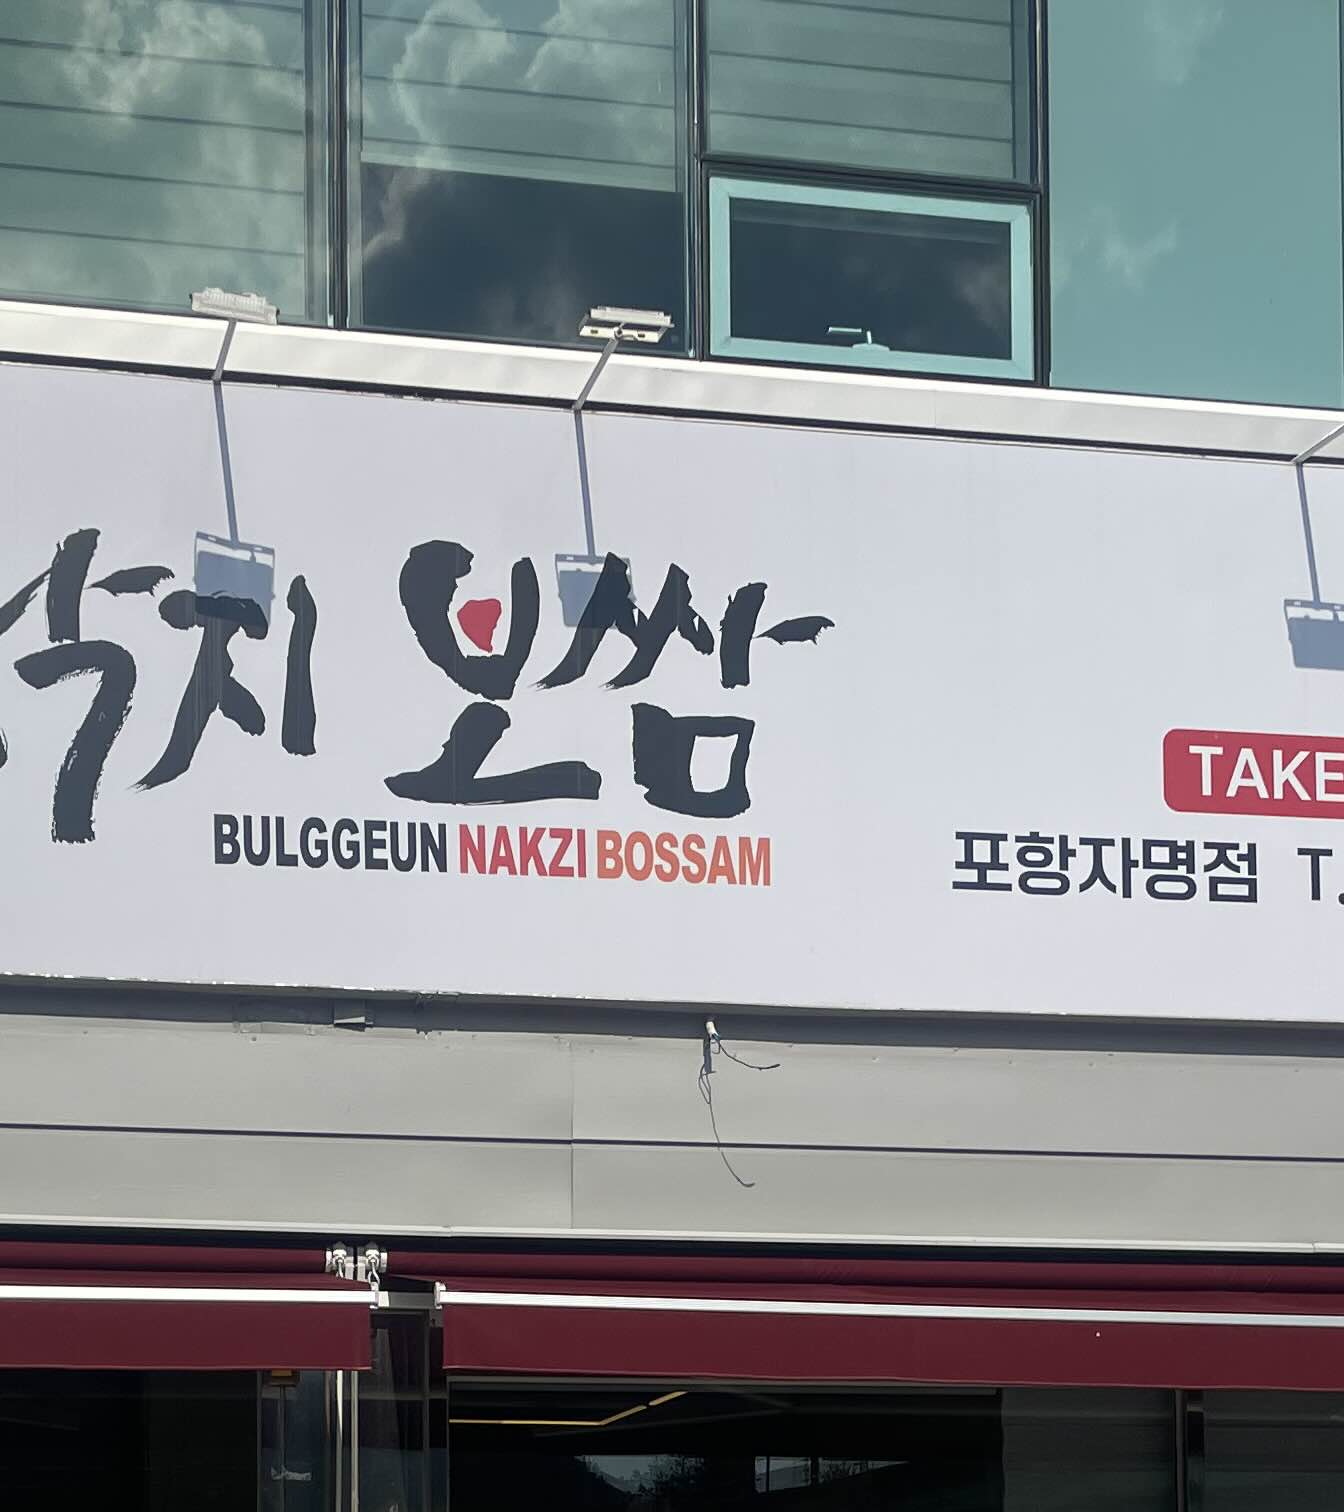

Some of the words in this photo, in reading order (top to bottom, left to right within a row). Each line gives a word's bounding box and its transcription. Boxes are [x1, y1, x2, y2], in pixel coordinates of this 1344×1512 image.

[383, 540, 836, 819] 보쌈
[213, 813, 448, 874] BULGGEUN
[459, 823, 587, 878] NAKZI
[597, 829, 772, 886] BOSSAM
[951, 831, 1259, 904] 포항자명점
